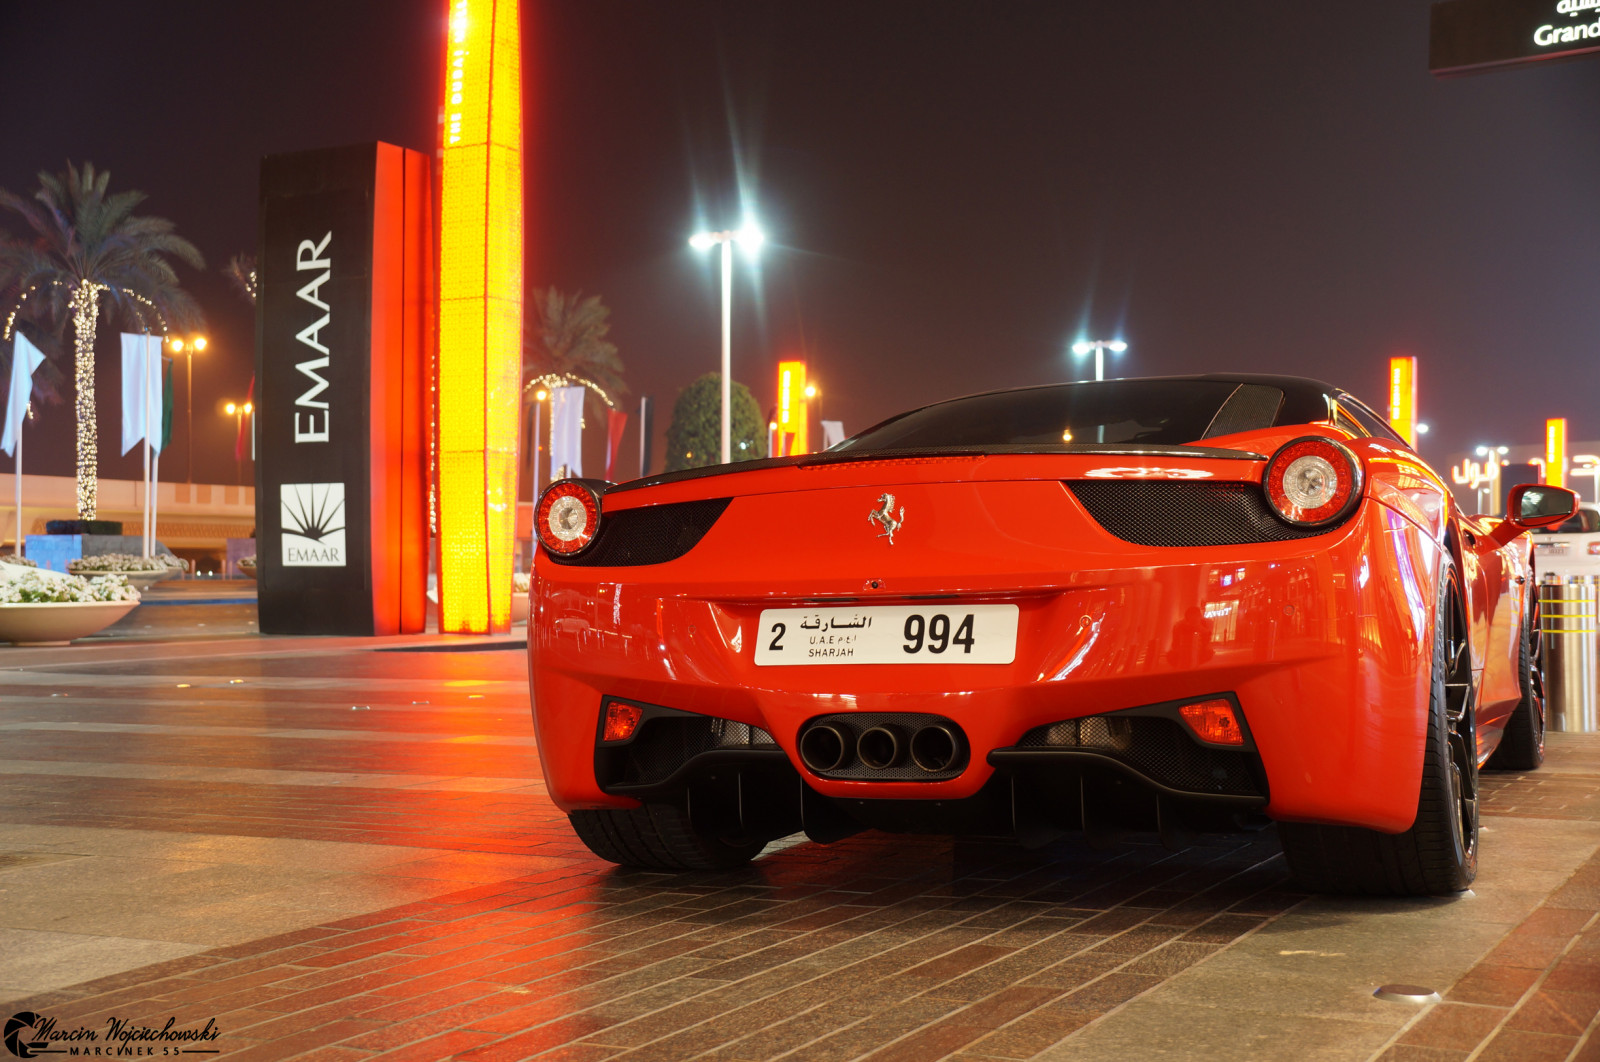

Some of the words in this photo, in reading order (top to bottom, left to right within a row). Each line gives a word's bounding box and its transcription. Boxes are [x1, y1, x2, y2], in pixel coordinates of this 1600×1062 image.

[294, 230, 332, 444] EMAAR
[287, 547, 340, 563] EMAAR
[800, 613, 873, 632] الشارقة
[768, 622, 786, 651] 2
[902, 613, 976, 654] 994
[808, 648, 854, 657] SHARJAH
